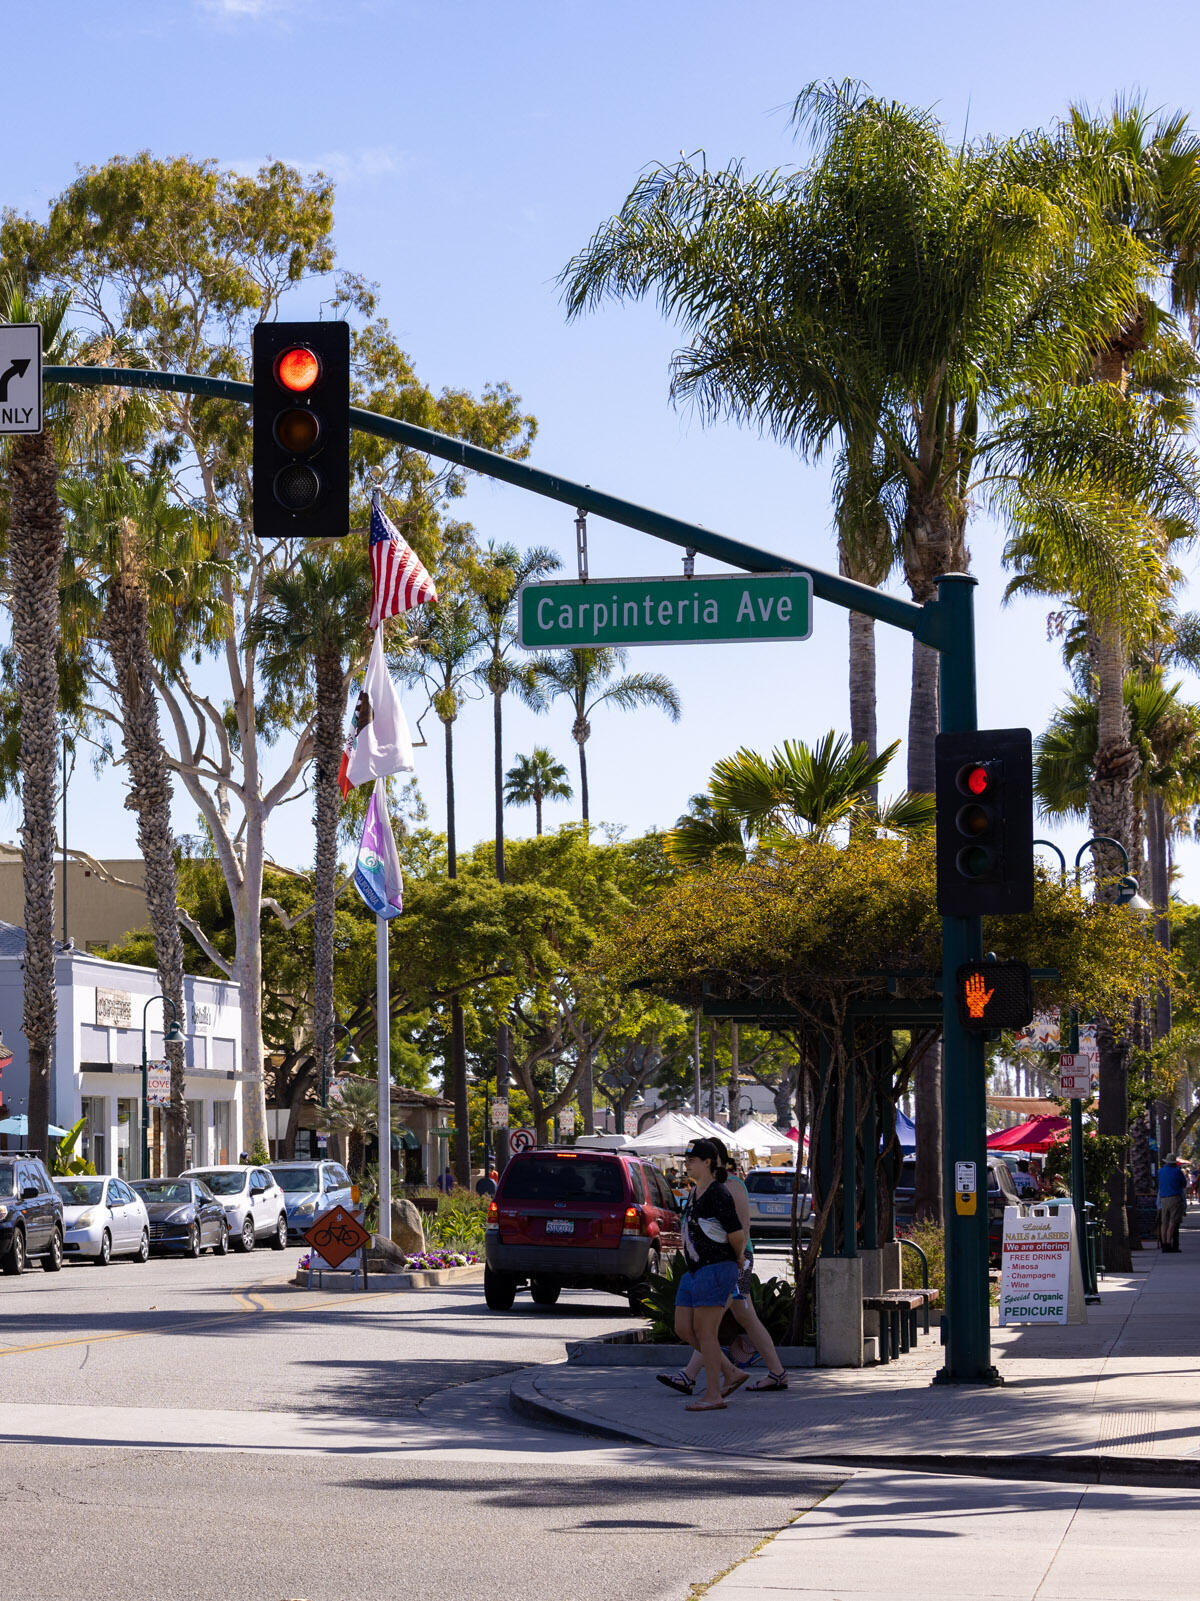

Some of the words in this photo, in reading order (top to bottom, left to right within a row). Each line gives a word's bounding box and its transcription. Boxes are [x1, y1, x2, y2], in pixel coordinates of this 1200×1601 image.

[537, 592, 718, 636] Carpinteria
[736, 590, 793, 622] Ave
[1062, 1056, 1072, 1065] NO
[148, 1080, 170, 1088] LOVE
[1063, 1078, 1073, 1087] NO
[1005, 1232, 1030, 1240] NAILS
[1037, 1232, 1069, 1240] LASHES
[1006, 1243, 1019, 1251] We
[1036, 1243, 1068, 1252] offering
[1033, 1293, 1064, 1302] Organic
[1004, 1306, 1064, 1316] PEDICURE
